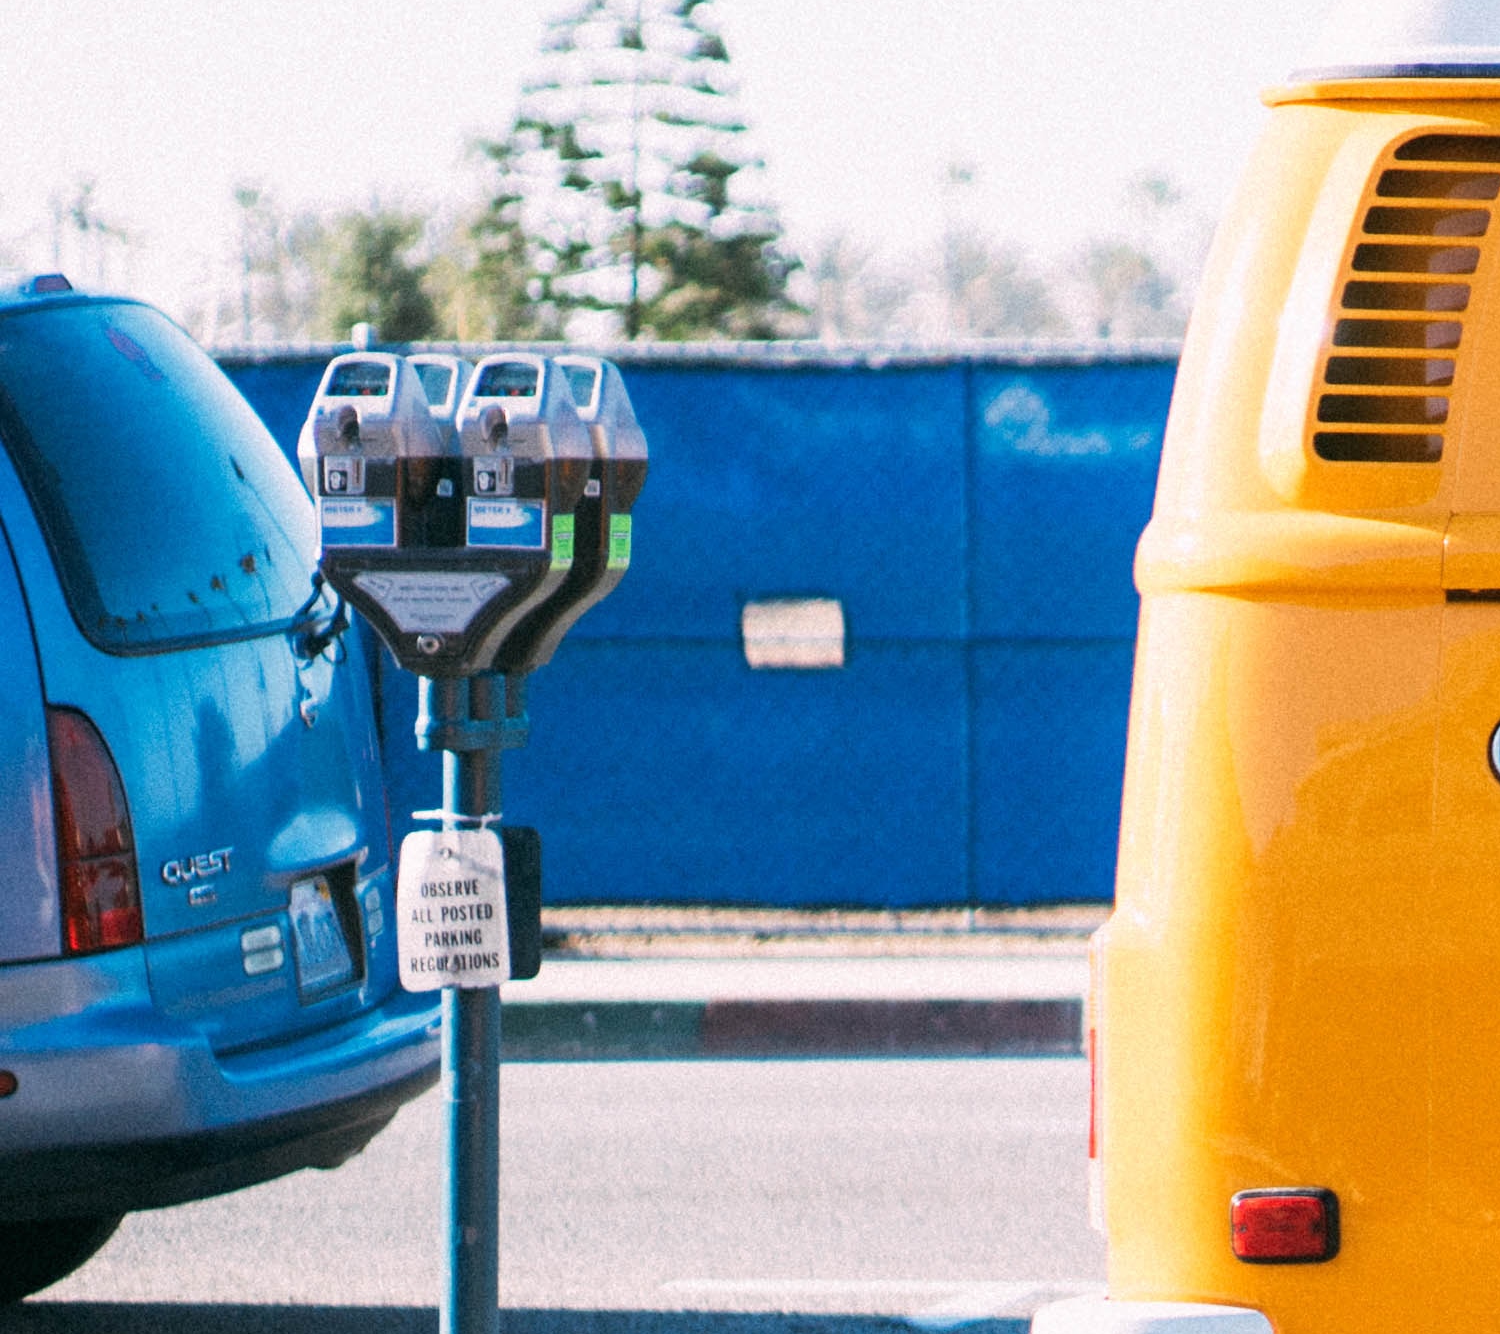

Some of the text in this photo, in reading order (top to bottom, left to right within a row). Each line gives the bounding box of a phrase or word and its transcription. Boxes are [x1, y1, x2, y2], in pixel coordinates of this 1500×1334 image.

[162, 846, 233, 884] QUEST
[421, 879, 479, 898] OBSERVE
[412, 903, 493, 923] ALL POSTED
[425, 929, 482, 947] PARKING
[411, 953, 500, 973] REGULATIONS
